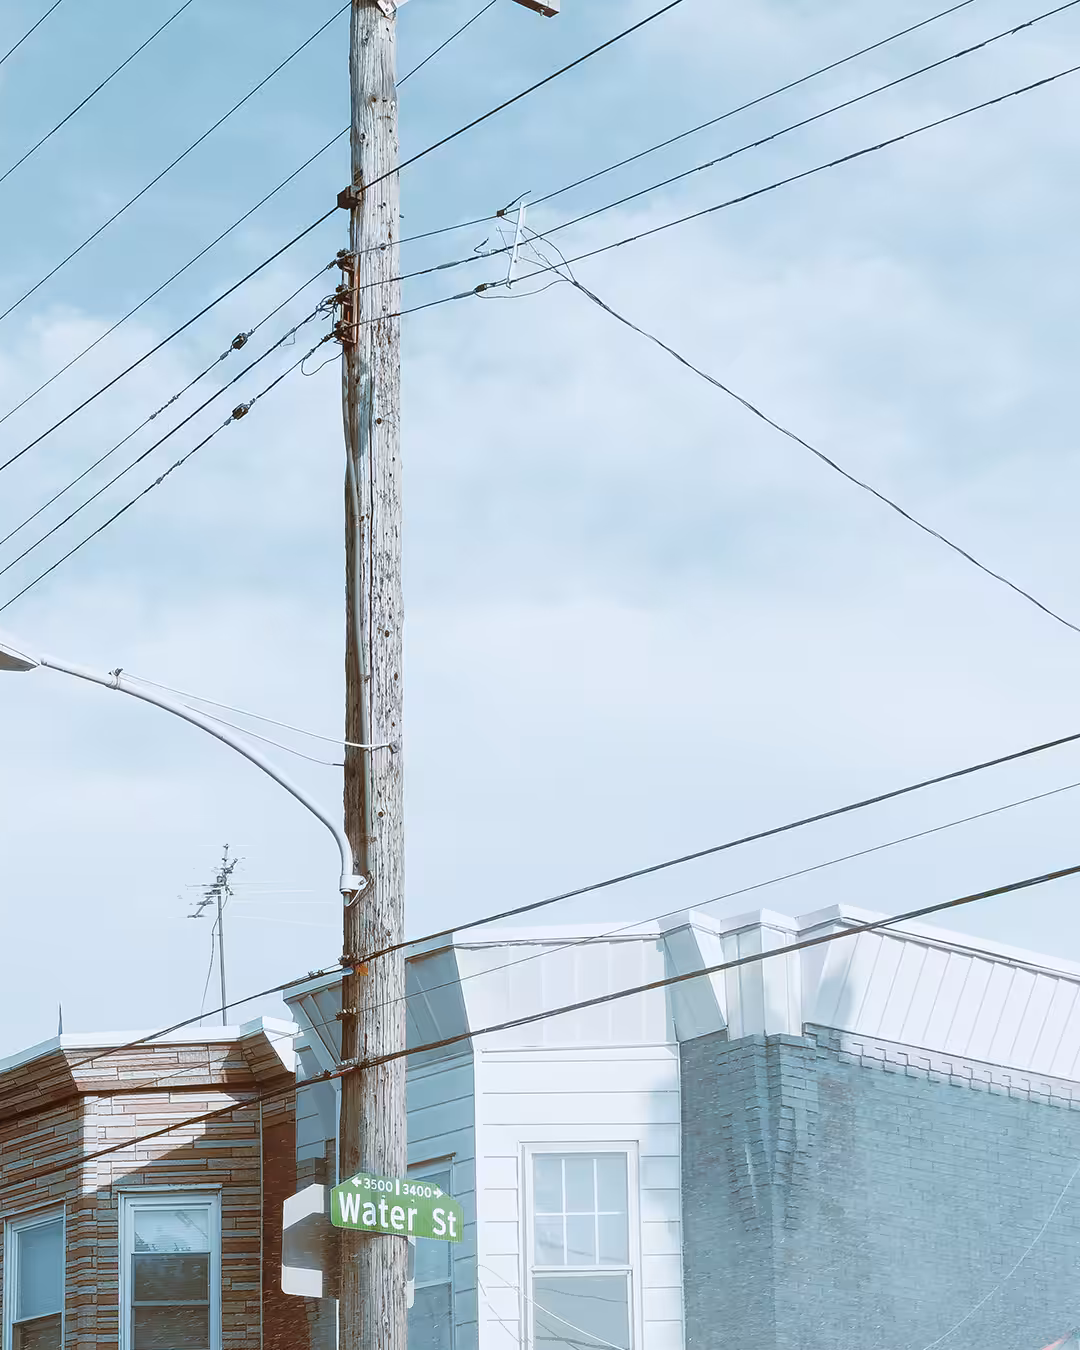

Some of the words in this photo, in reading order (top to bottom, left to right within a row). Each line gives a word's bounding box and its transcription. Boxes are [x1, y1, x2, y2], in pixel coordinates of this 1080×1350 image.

[364, 1178, 393, 1193] 3500
[402, 1184, 432, 1198] 3400
[338, 1191, 418, 1232] Water
[432, 1207, 457, 1238] St
